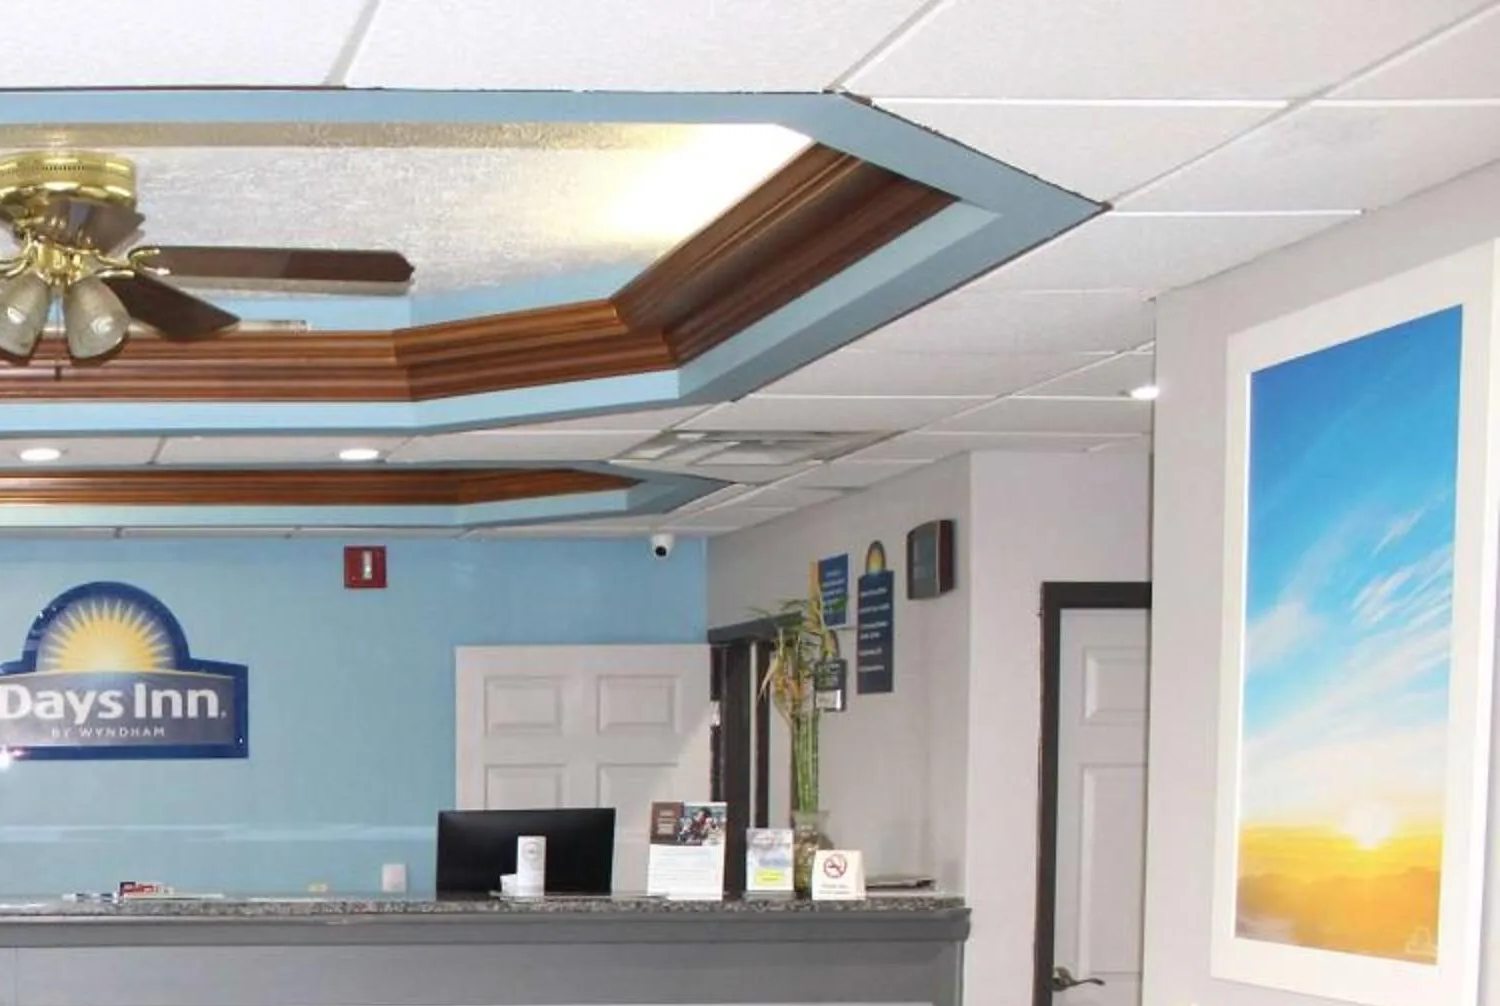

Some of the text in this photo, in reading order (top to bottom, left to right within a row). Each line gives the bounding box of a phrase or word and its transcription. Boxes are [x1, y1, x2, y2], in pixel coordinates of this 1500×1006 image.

[134, 683, 218, 719] Inn
[51, 726, 167, 738] BY WYNDHAM
